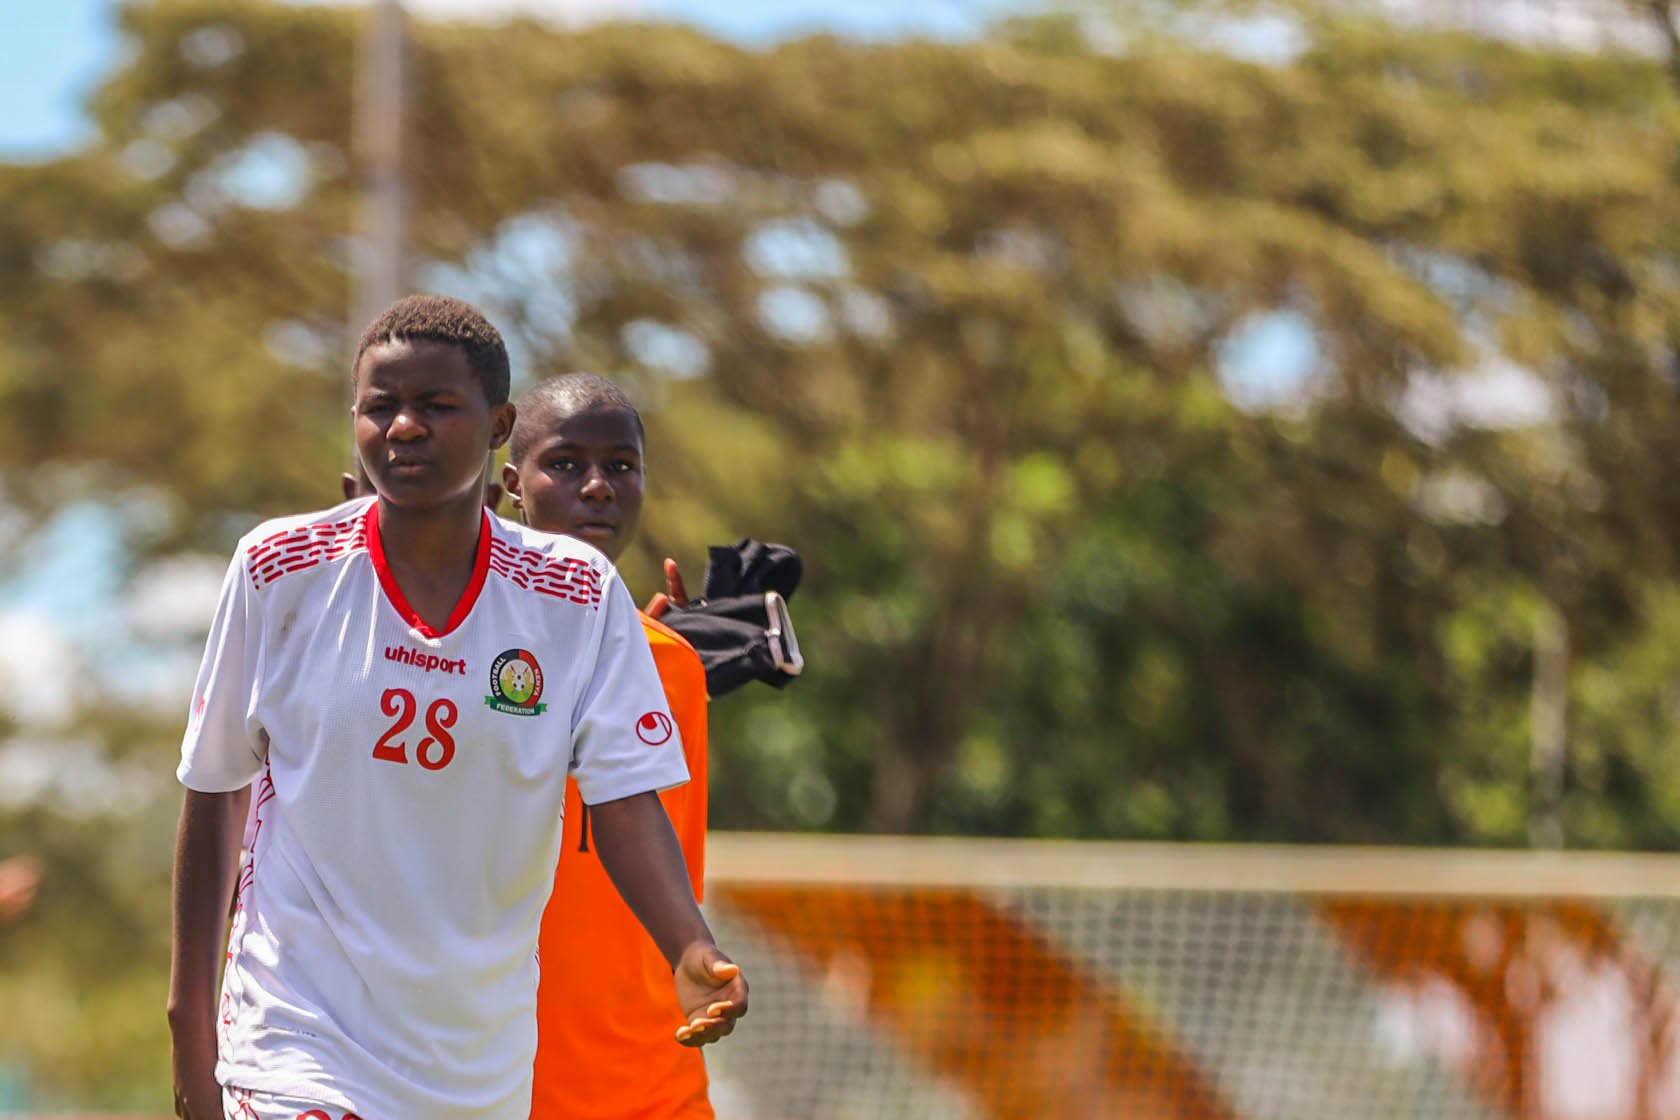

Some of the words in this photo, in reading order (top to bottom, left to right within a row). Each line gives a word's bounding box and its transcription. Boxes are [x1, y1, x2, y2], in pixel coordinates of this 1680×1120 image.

[384, 646, 466, 675] uhlsport
[492, 657, 506, 696] FOOTBALL
[372, 688, 458, 770] 28
